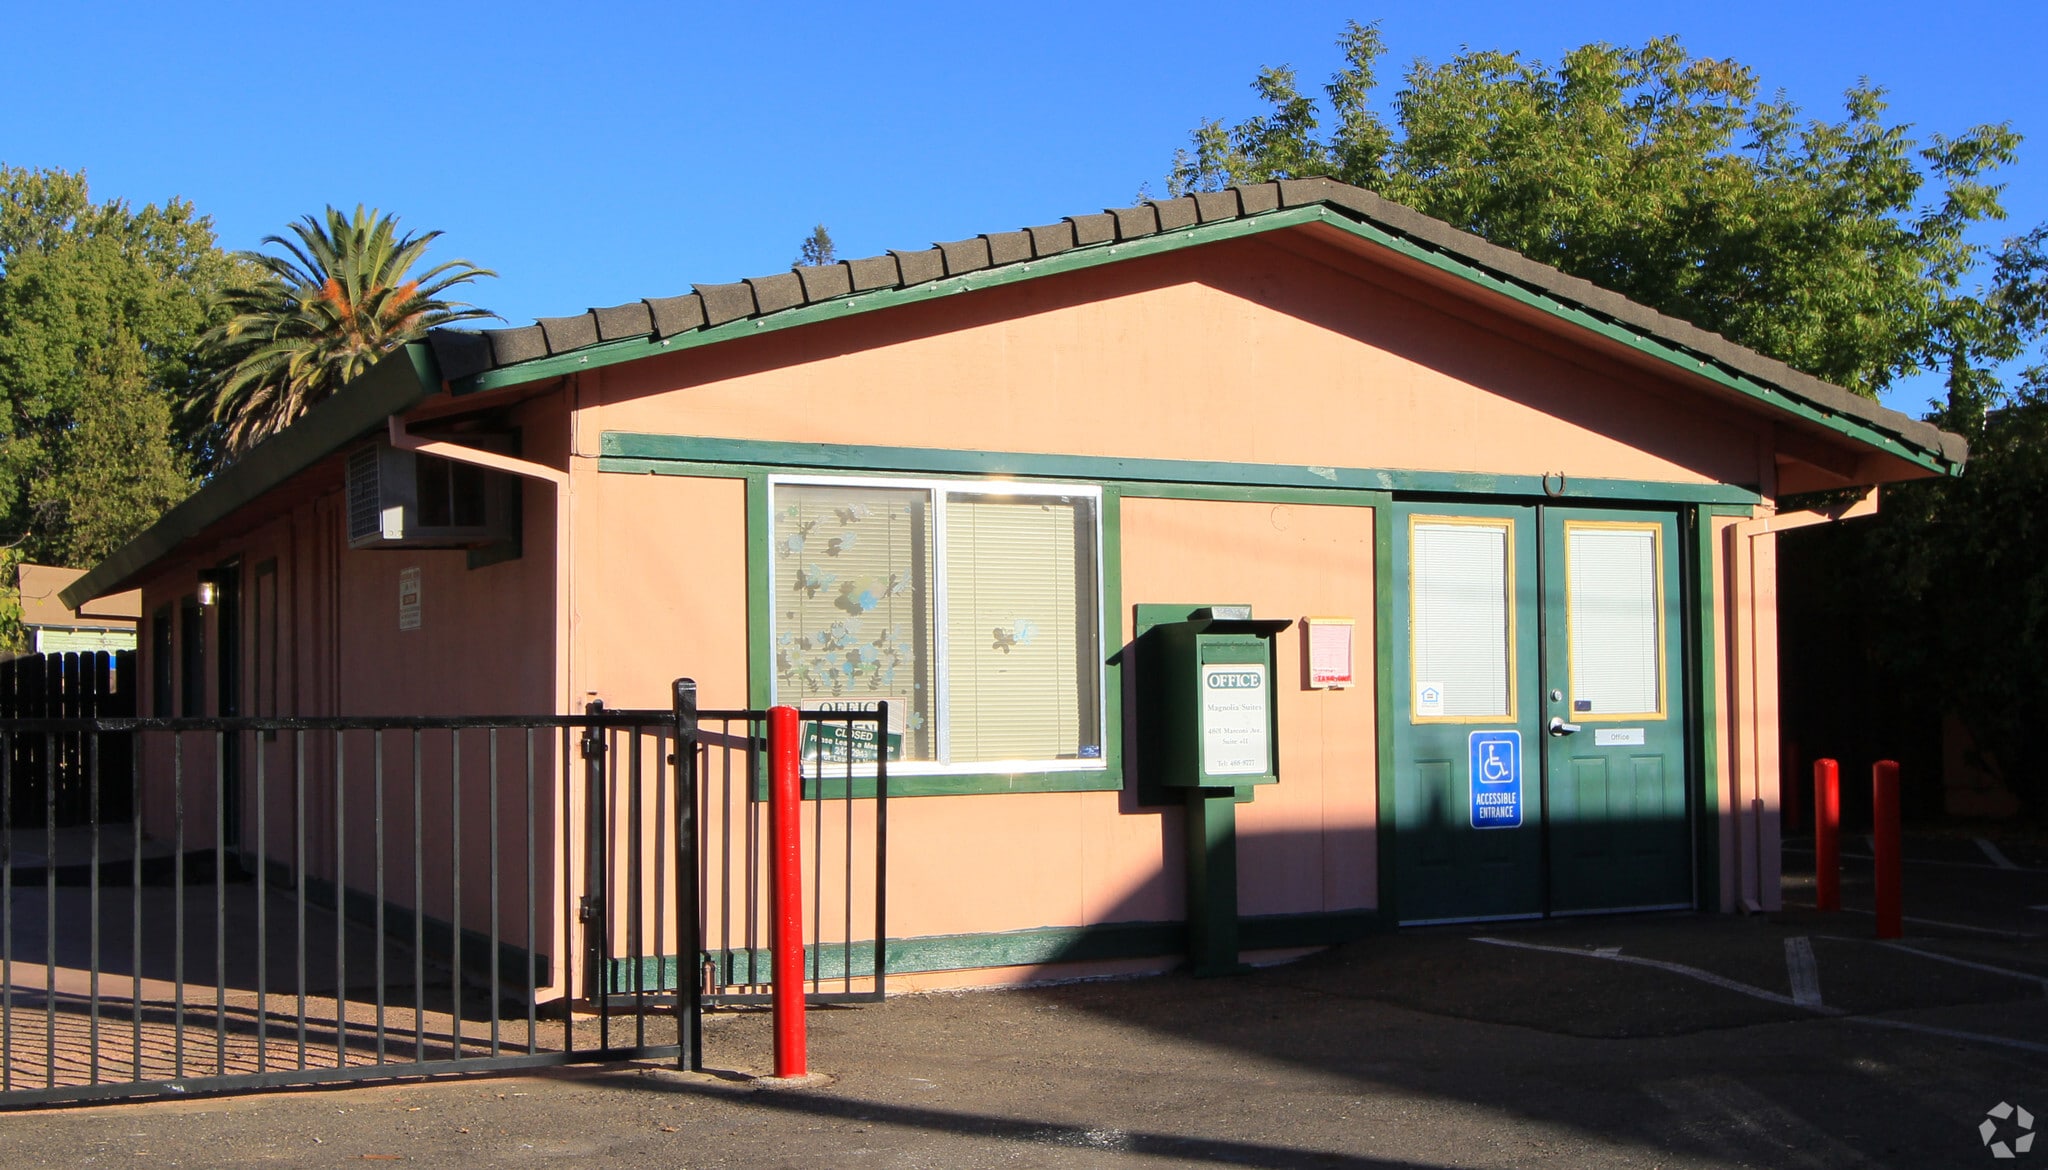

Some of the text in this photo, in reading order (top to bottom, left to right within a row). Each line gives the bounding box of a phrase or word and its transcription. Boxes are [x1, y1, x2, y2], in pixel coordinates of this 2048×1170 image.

[1209, 674, 1260, 688] OFFICE
[1208, 703, 1262, 713] Magnolia Suites
[835, 728, 873, 741] CLSED
[1610, 733, 1630, 741] Office
[1476, 792, 1516, 806] ACCESSIBLE
[1479, 805, 1514, 819] ENTRANCE
